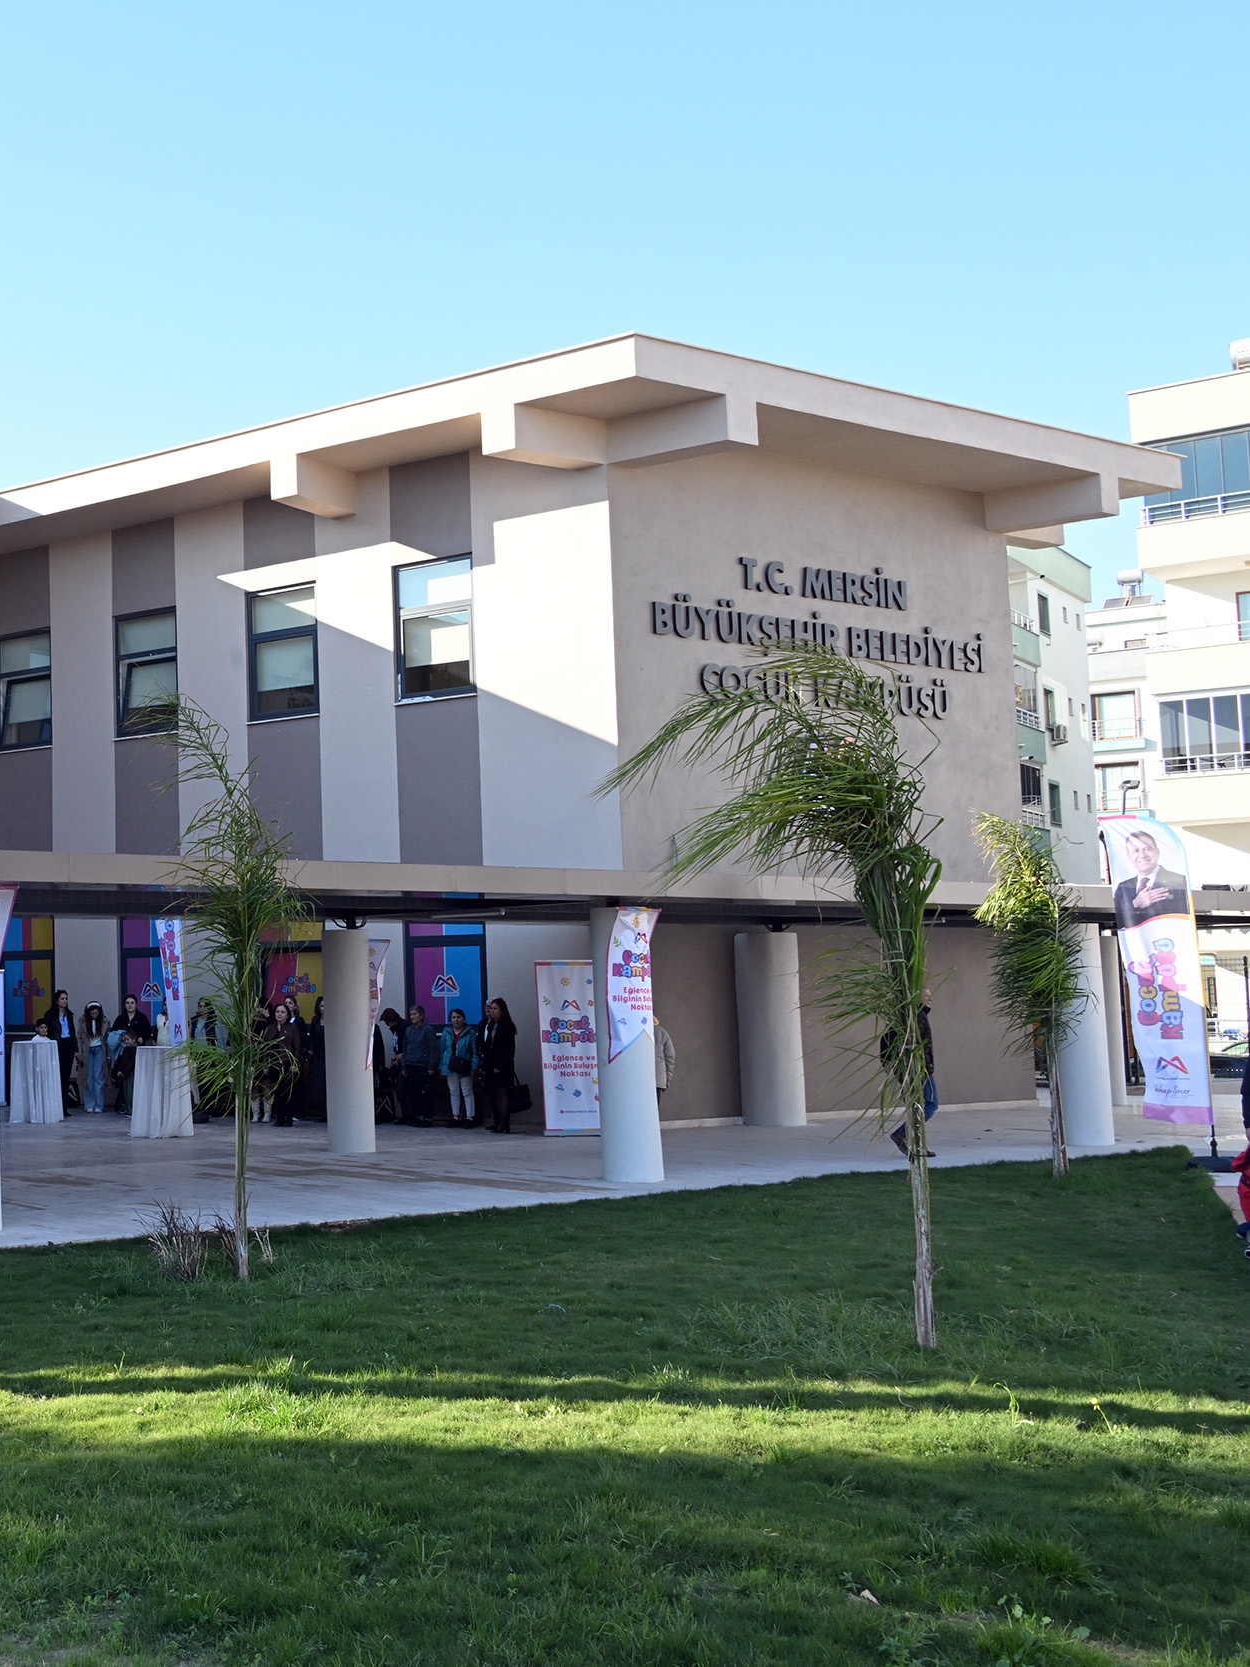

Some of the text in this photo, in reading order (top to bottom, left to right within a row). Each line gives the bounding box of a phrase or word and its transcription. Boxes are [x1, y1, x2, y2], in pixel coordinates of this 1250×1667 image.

[739, 556, 908, 611] T.C. MERSİN
[652, 593, 986, 673] BÜYÜKŞEHİR BELEDİYESİ
[613, 995, 642, 1003] Bilginin
[1128, 952, 1162, 1027] Çocuk
[1152, 937, 1187, 1040] Kampüsü
[542, 1030, 596, 1047] Kampüs
[543, 1062, 572, 1070] Bilginin
[552, 1054, 584, 1063] Eğlence
